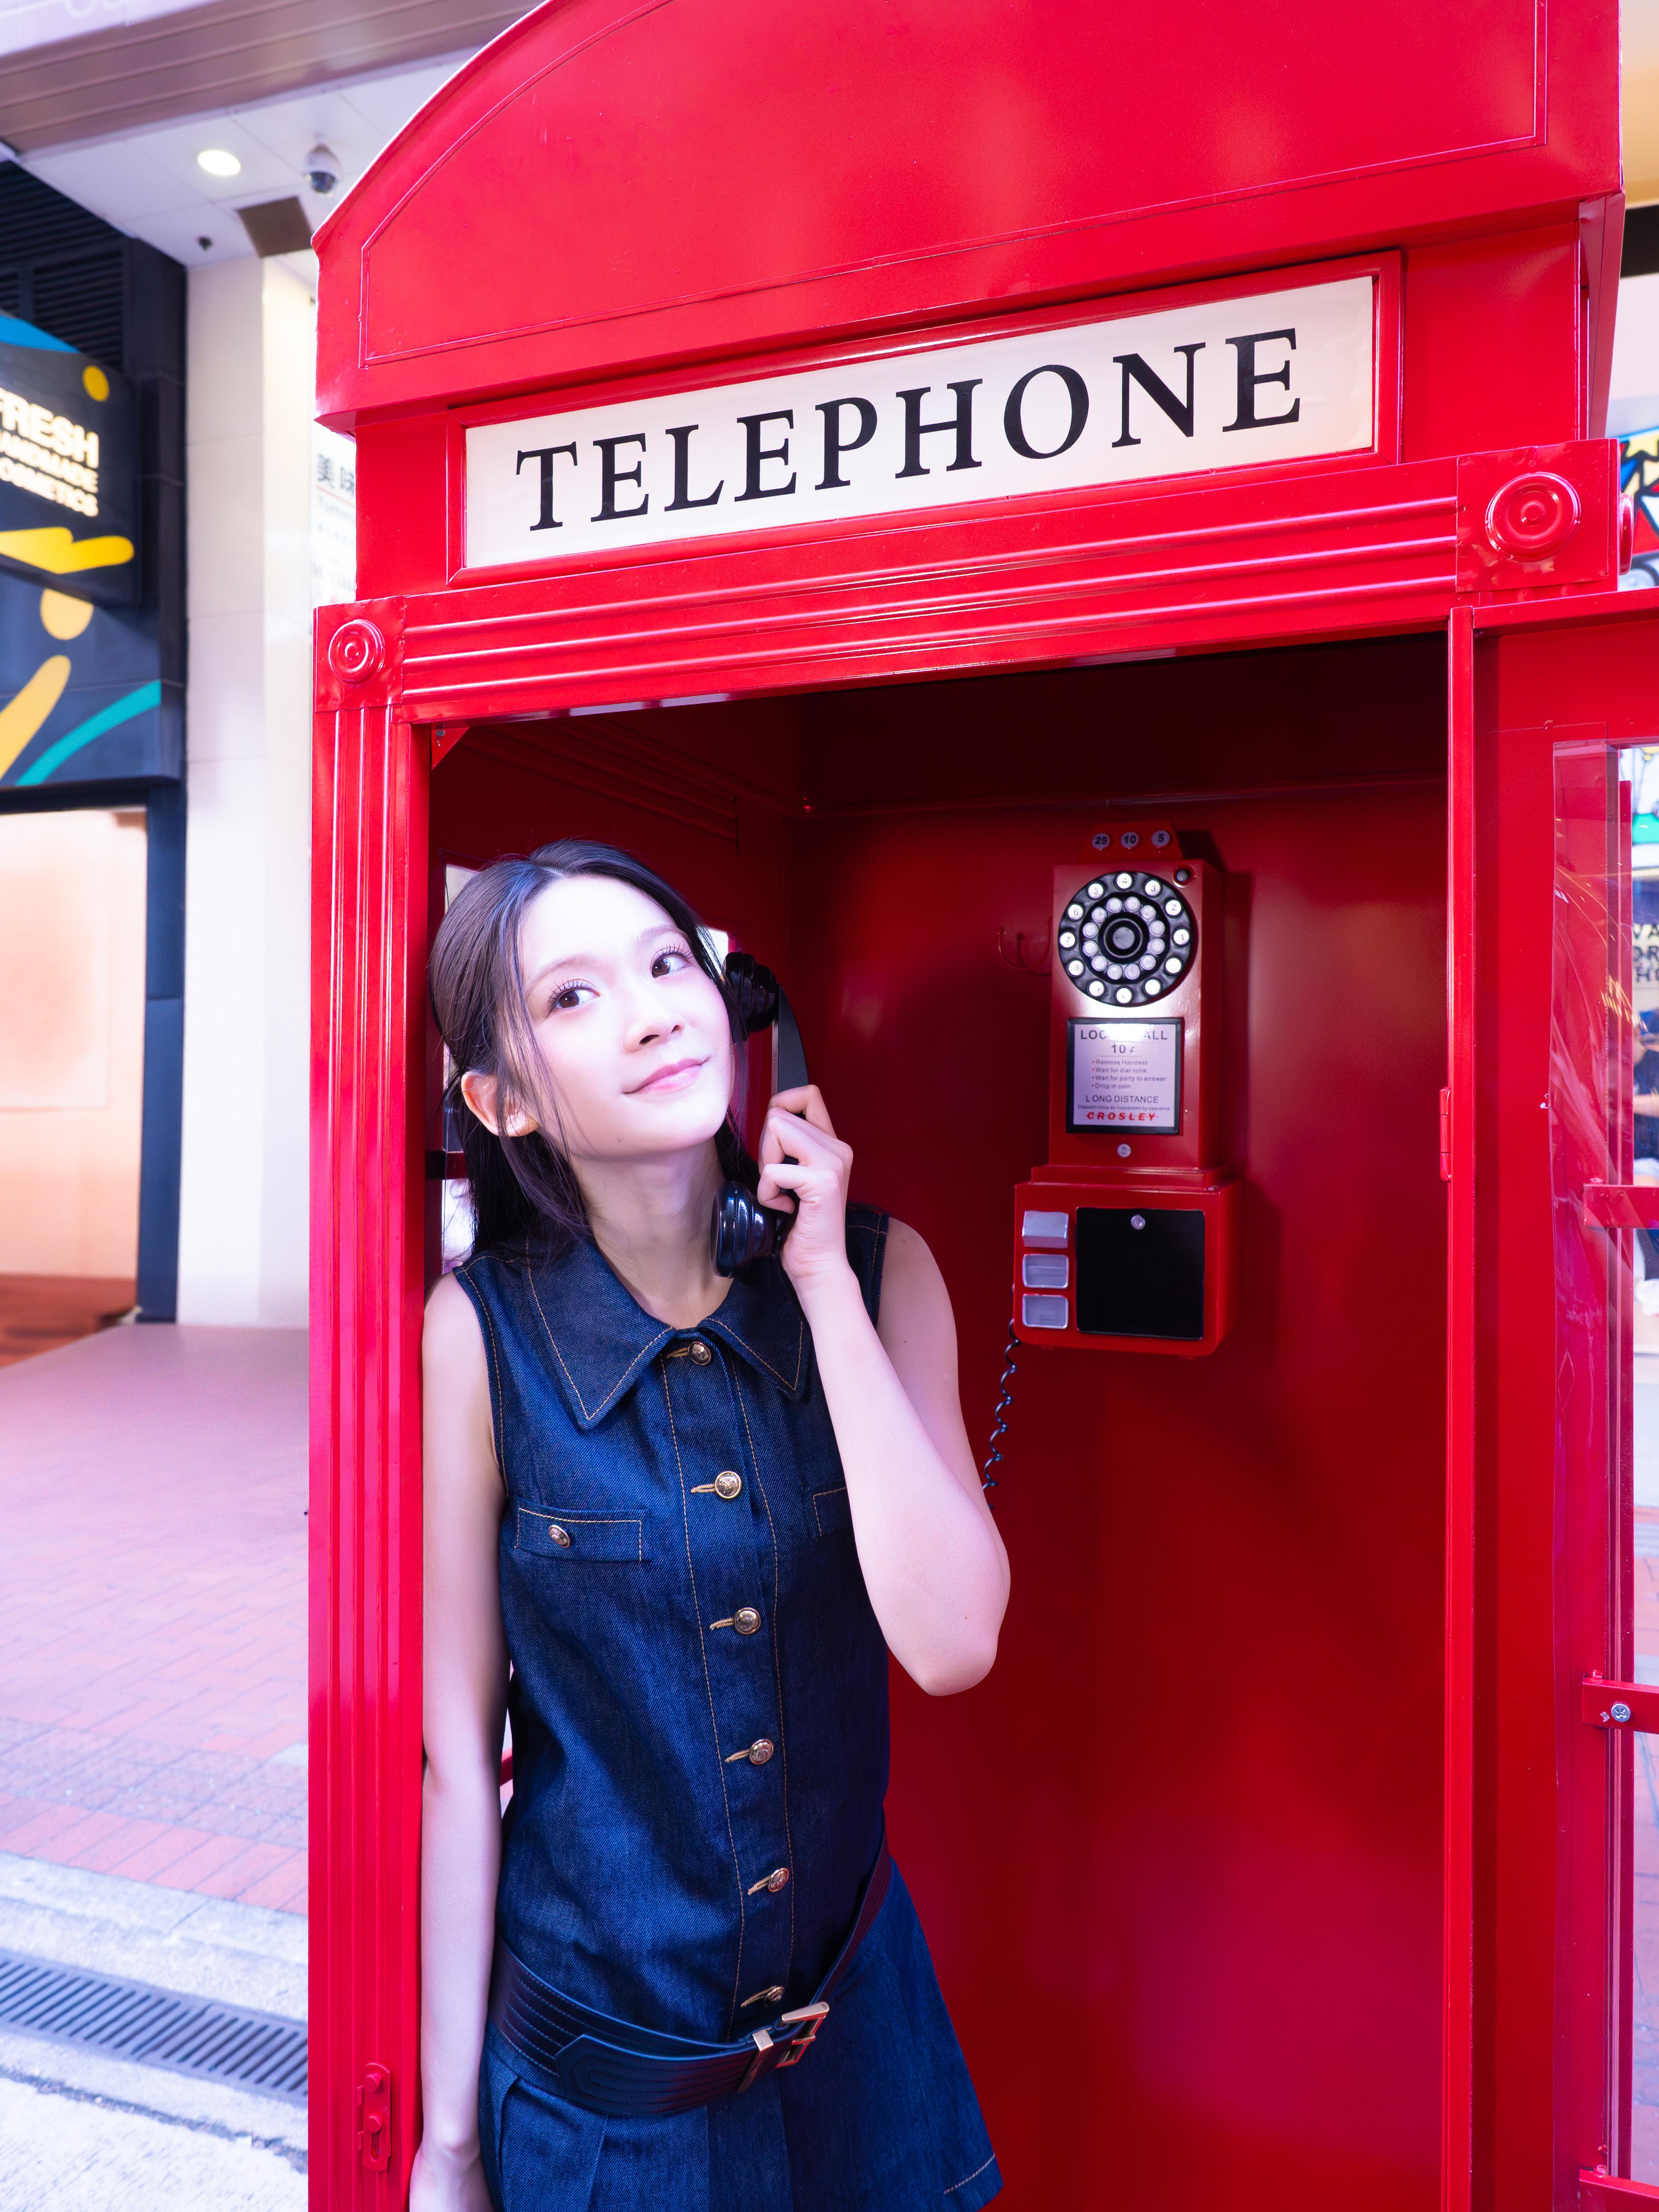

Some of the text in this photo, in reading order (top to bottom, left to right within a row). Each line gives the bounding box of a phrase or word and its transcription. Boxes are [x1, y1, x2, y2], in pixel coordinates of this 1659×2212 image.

[0, 388, 99, 469] RESH
[516, 328, 1301, 531] TELEPHONE
[1094, 834, 1165, 845] 25 10 5
[1636, 968, 1659, 982] H
[1143, 1030, 1168, 1040] ALL
[1085, 1094, 1159, 1103] LONG DISTANCE
[1086, 1111, 1156, 1121] CROSLEY
